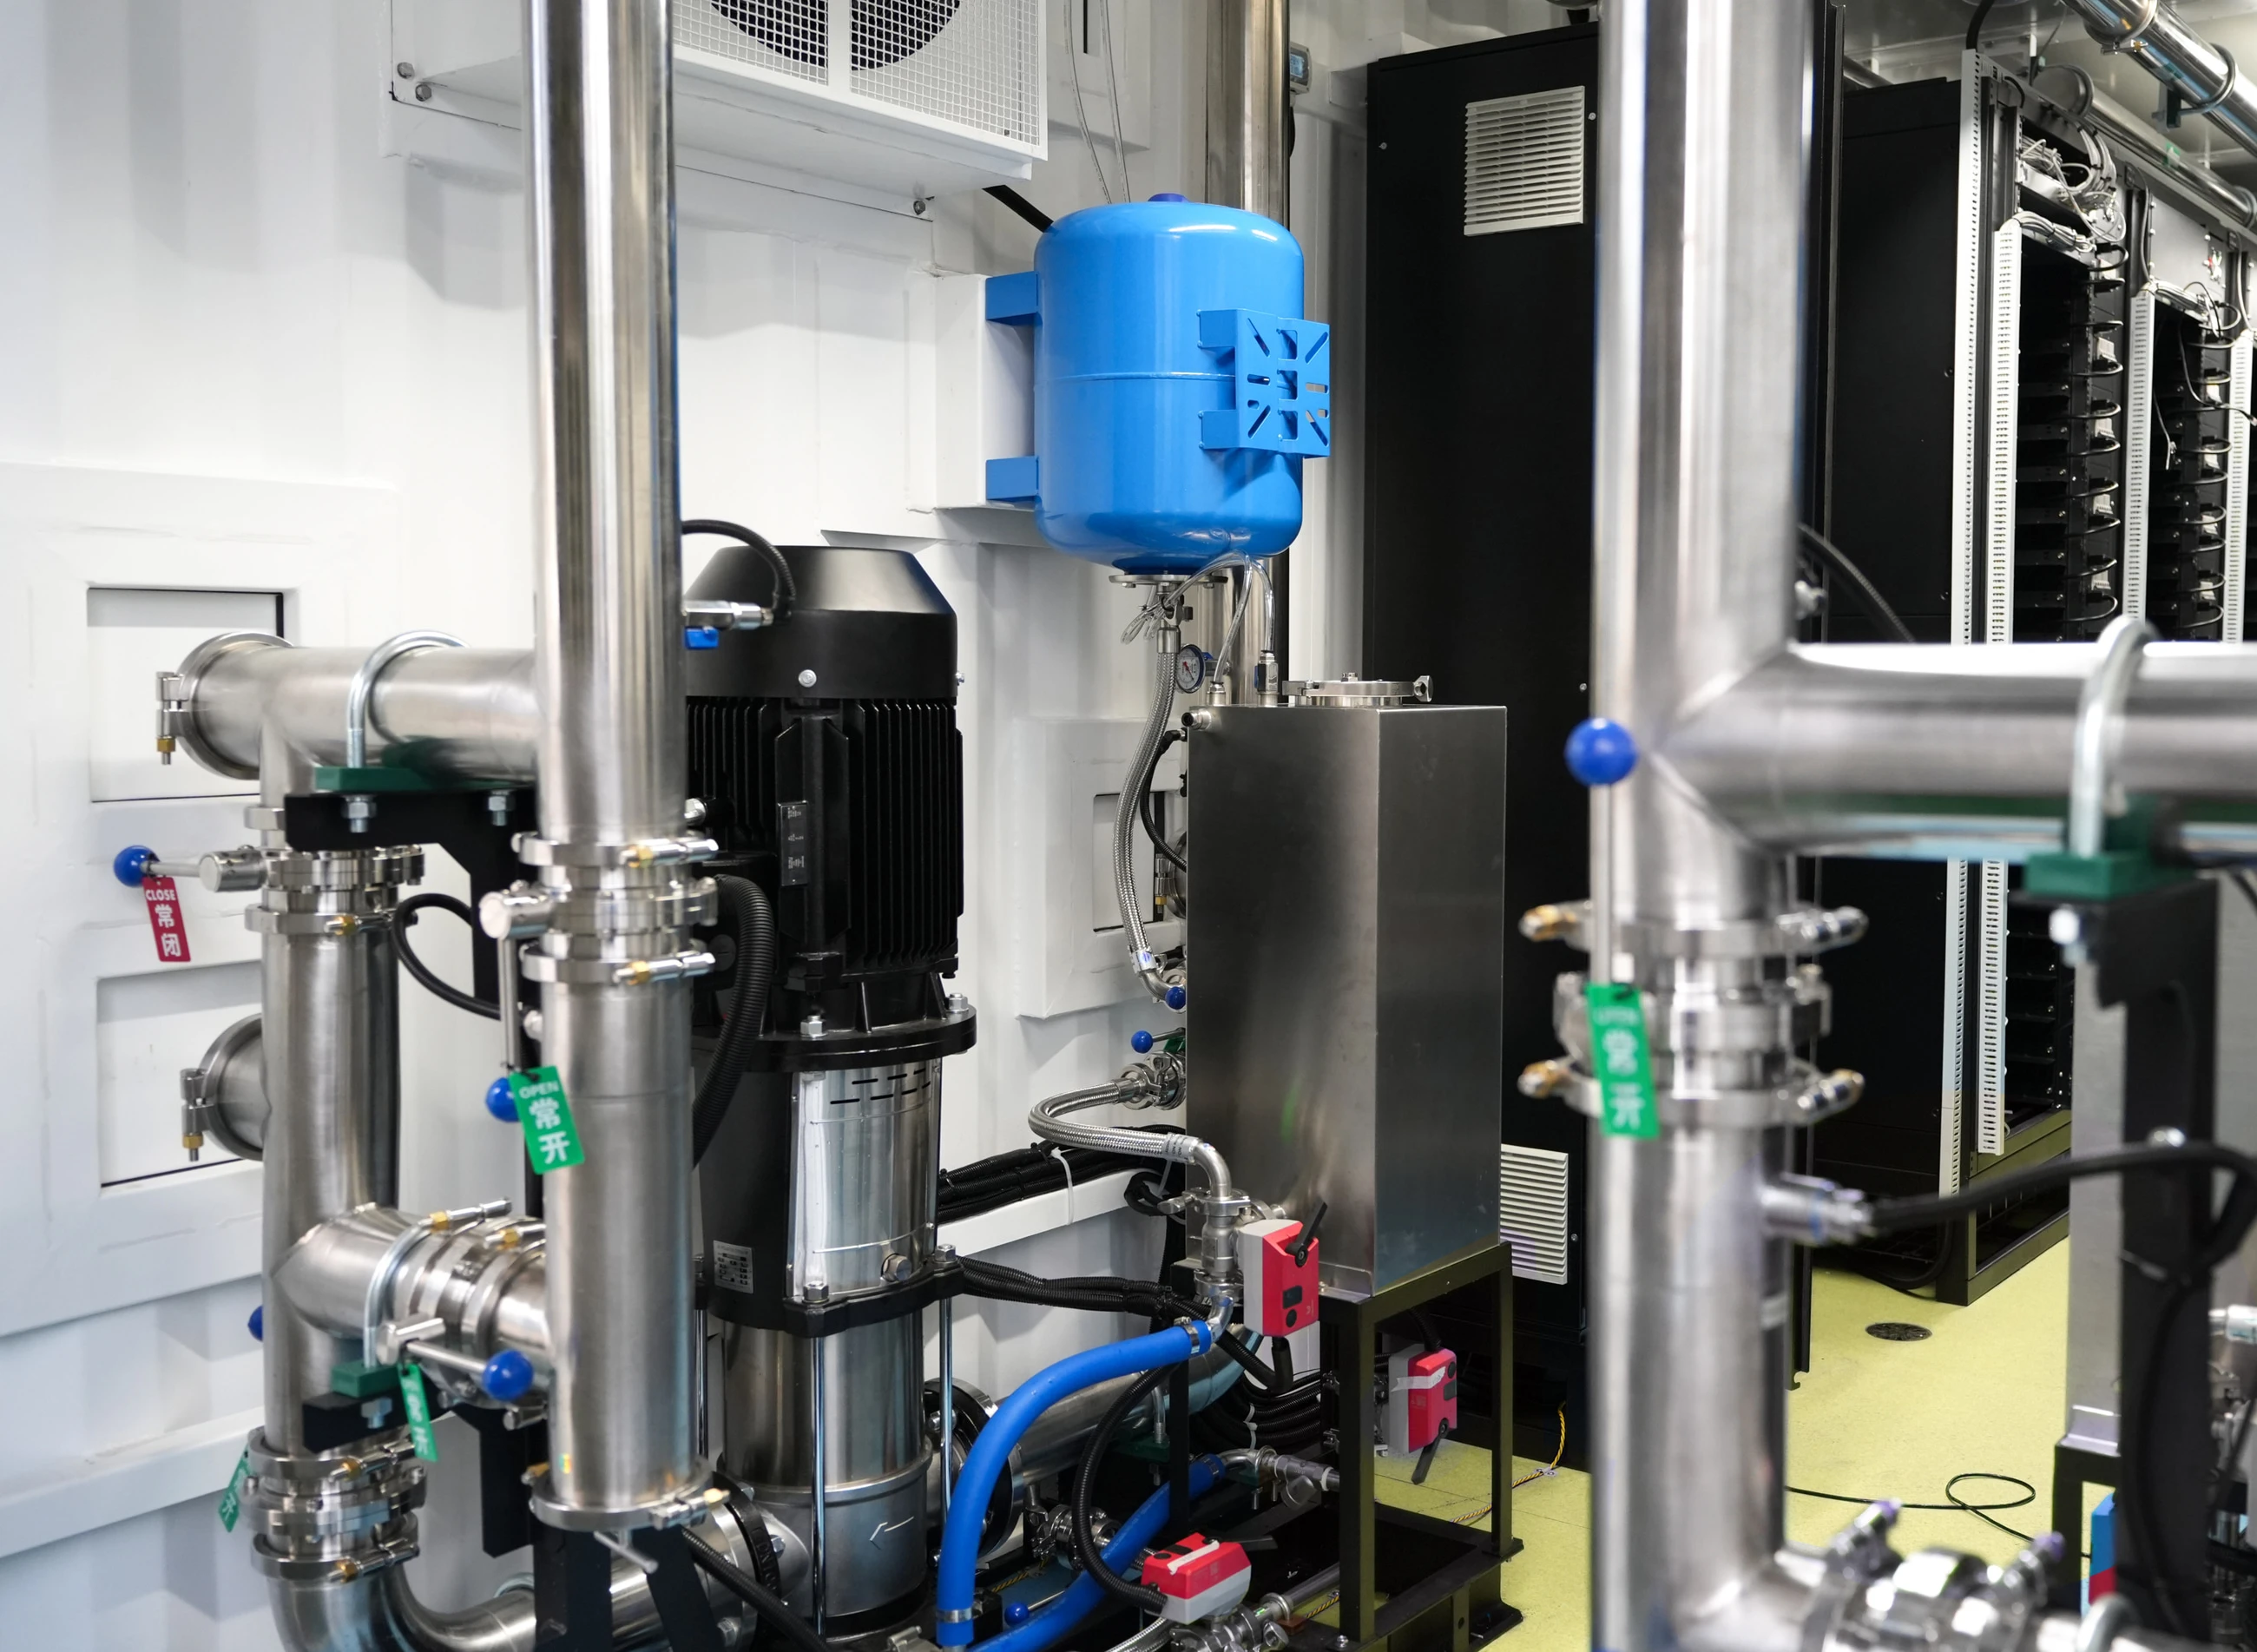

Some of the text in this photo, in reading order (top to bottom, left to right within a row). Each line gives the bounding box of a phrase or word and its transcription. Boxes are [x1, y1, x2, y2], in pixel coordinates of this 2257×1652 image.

[145, 889, 176, 901] CLOSE
[155, 904, 181, 957] 常闭
[518, 1080, 560, 1099] OPEN
[529, 1096, 570, 1164] 常开
